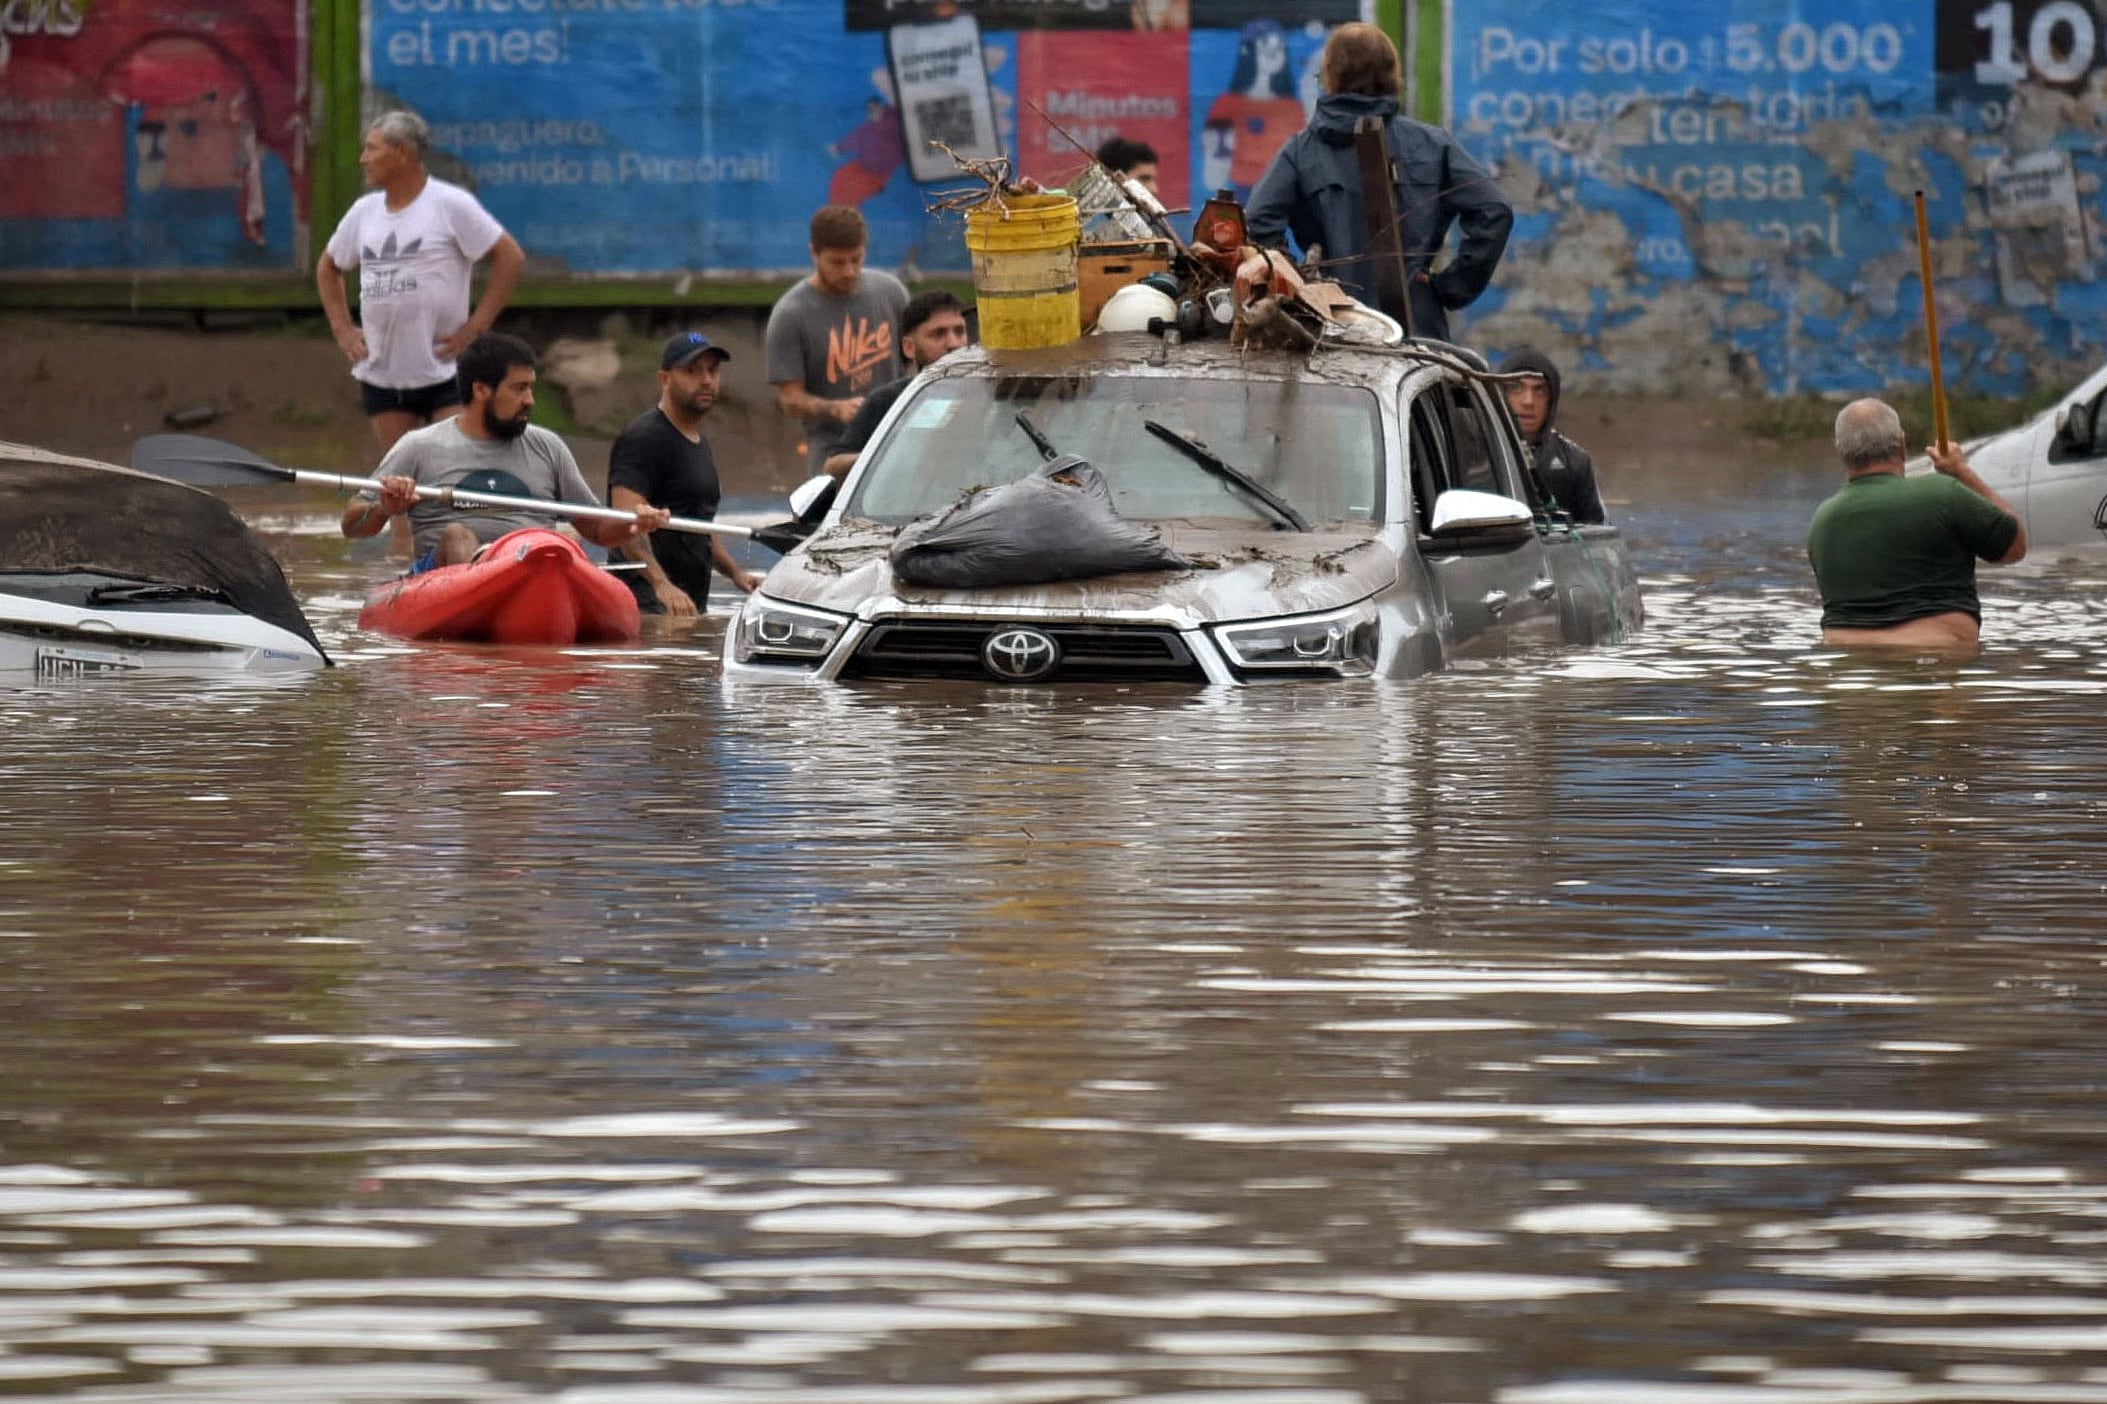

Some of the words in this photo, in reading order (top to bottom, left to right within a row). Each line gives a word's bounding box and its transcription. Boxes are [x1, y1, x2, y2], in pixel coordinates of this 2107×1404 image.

[389, 22, 434, 65] el
[1578, 27, 1688, 73] solo
[1672, 163, 1803, 204] casa
